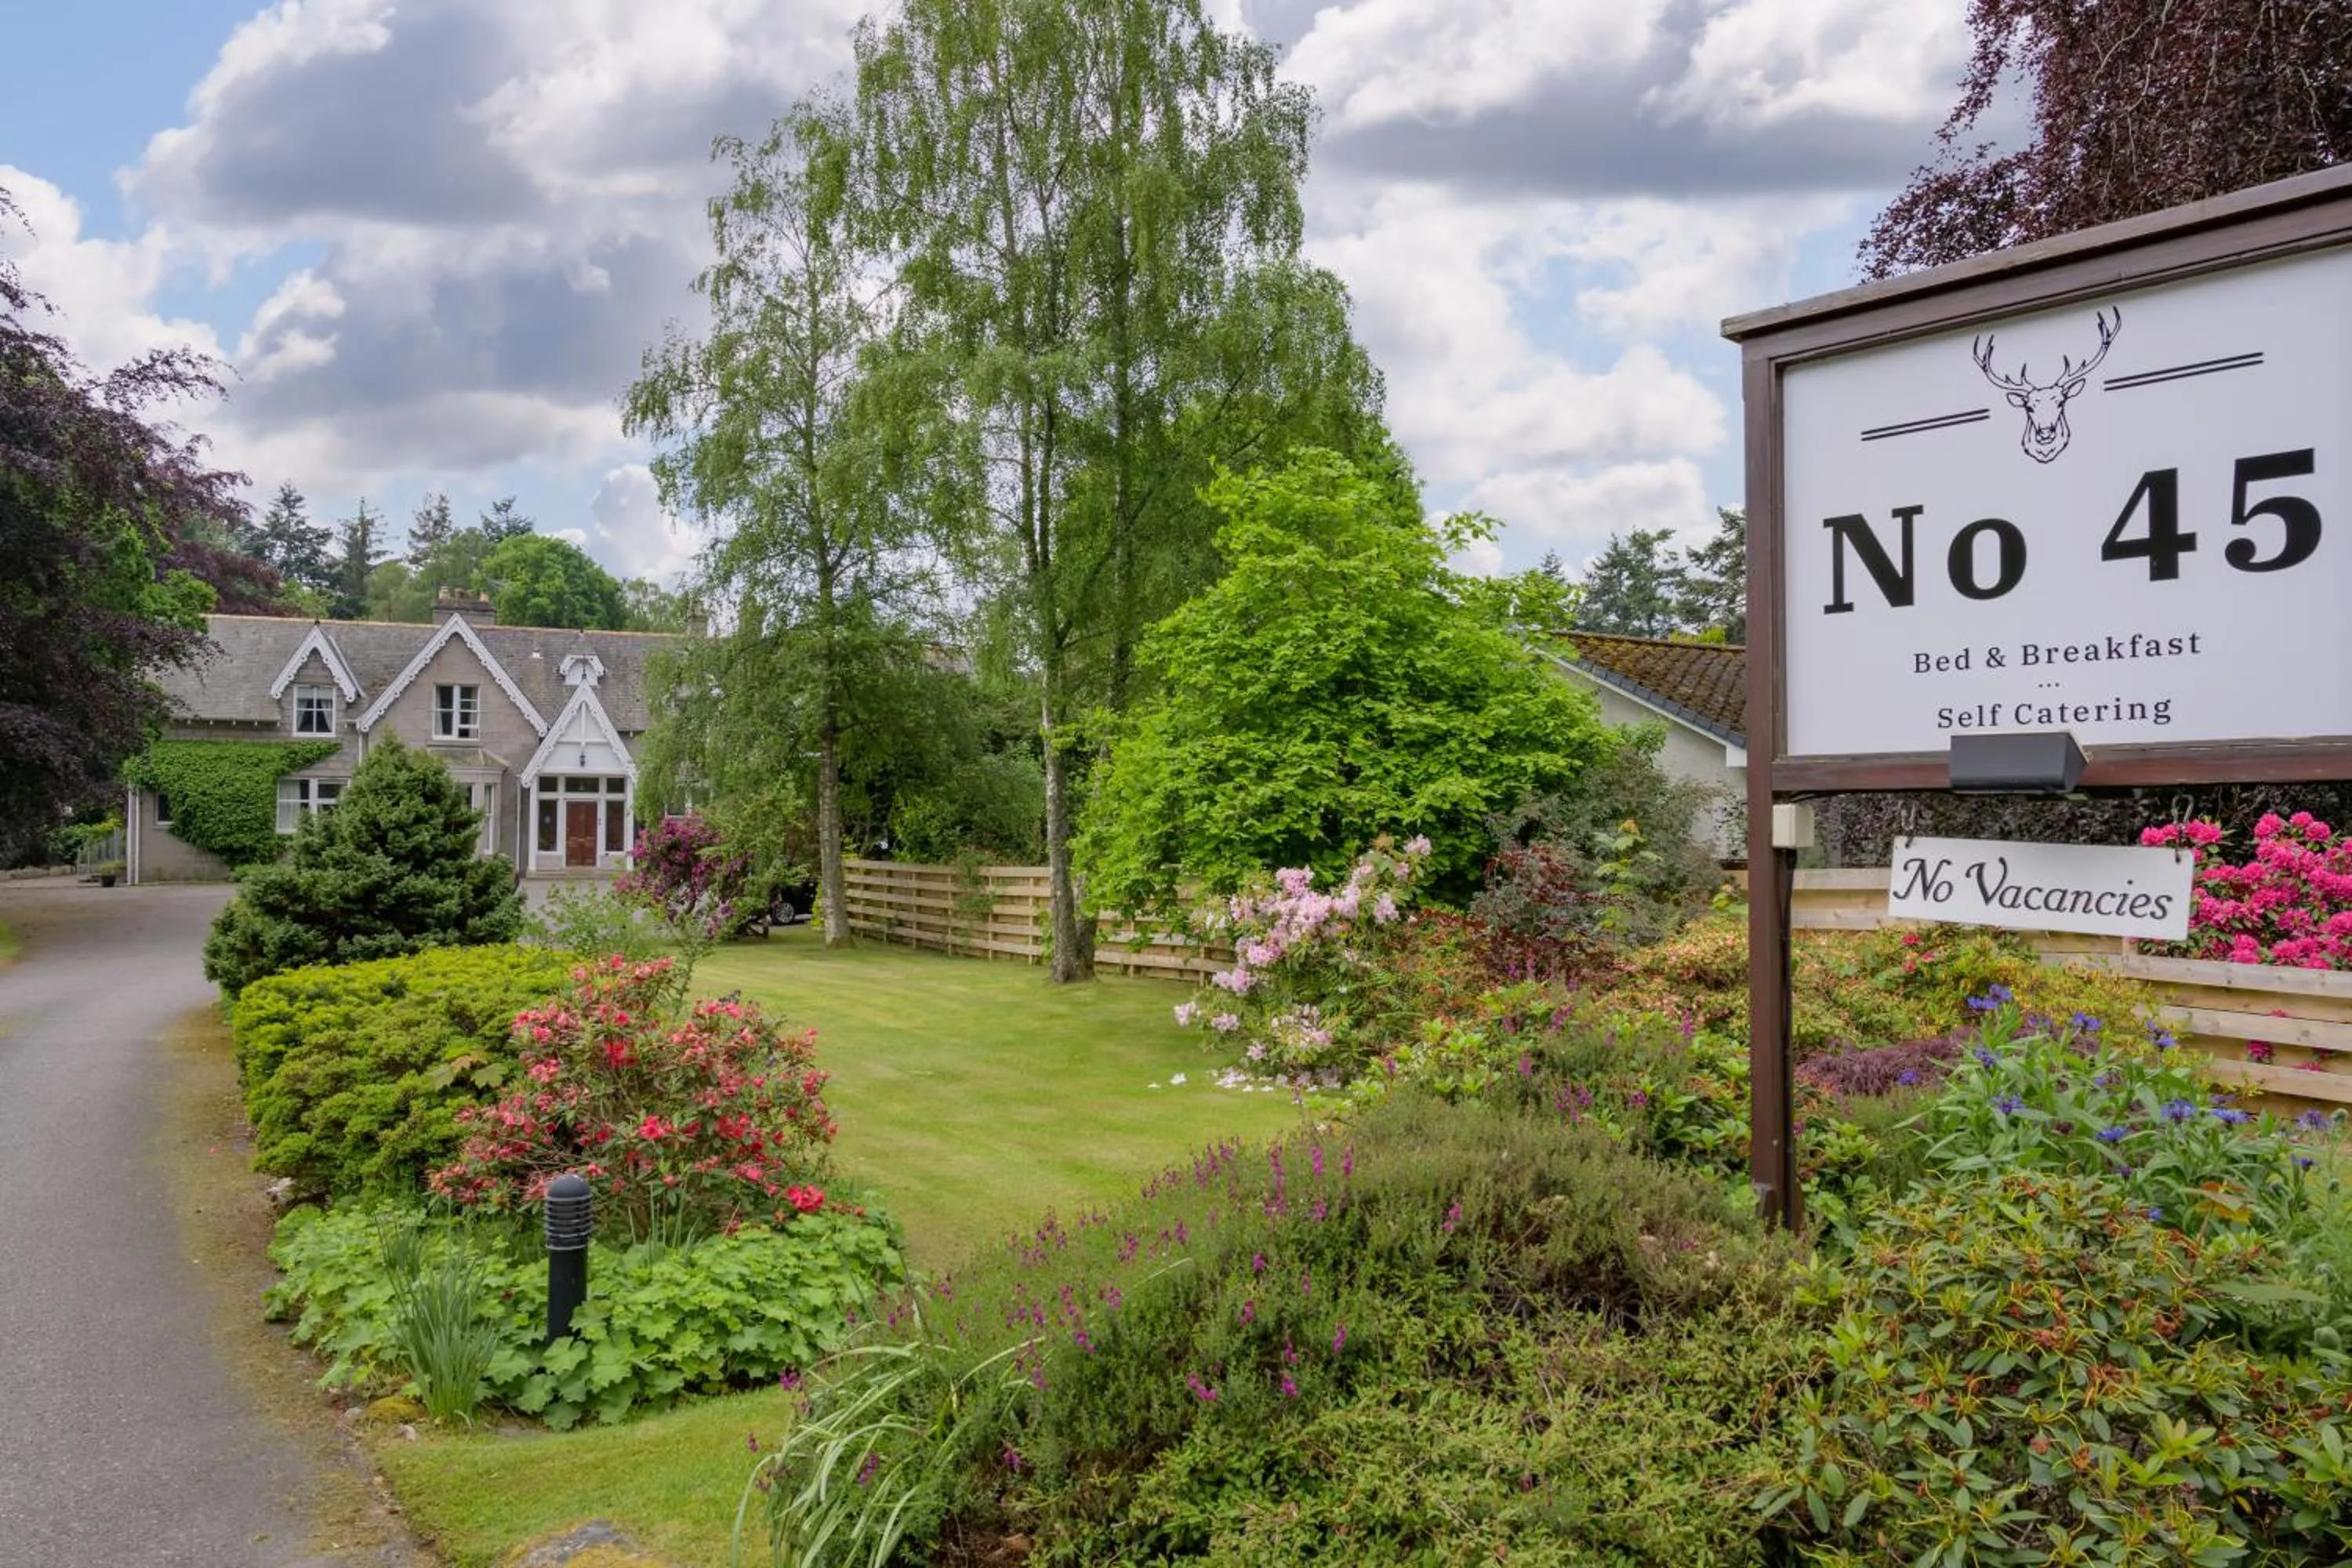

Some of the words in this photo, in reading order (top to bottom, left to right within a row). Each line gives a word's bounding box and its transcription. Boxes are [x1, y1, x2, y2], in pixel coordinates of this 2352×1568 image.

[1822, 503, 2027, 615] No
[2100, 447, 2323, 583] 45
[1913, 647, 1971, 674] Bed
[1985, 646, 2007, 670] &
[2020, 632, 2201, 667] Breakfast
[1936, 702, 2003, 729] Self
[2013, 696, 2172, 726] Catering
[1893, 857, 1955, 904] No
[1965, 856, 2174, 920] Vacancies
